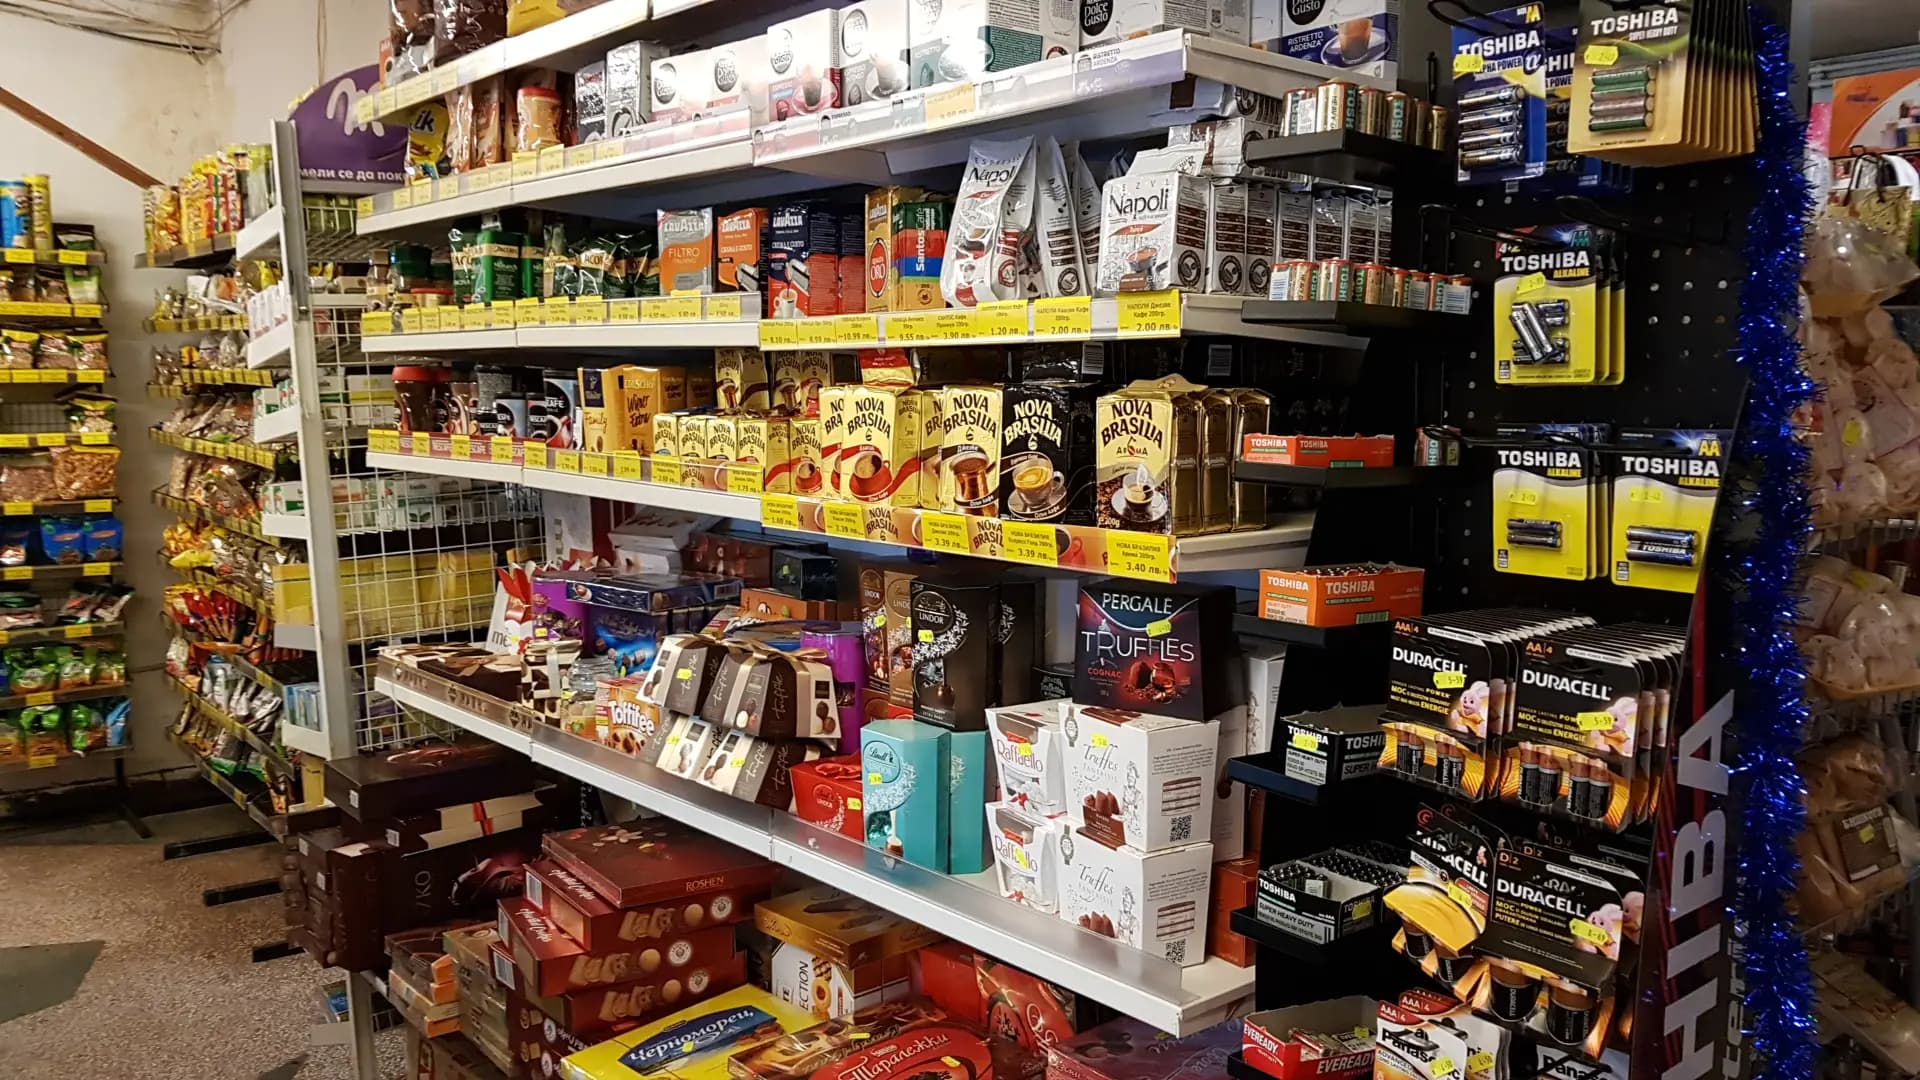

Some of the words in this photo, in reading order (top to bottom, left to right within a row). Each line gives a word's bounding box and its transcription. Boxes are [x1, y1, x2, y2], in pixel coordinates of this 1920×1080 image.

[1084, 1, 1109, 18] Dolce
[1292, 0, 1321, 16] Gusto
[1084, 10, 1109, 28] Gusto
[1591, 7, 1679, 36] TOSHIBA
[1287, 31, 1324, 46] RISTRETTO
[1289, 39, 1325, 53] ARDENZA
[1459, 30, 1541, 57] TOSHIBA
[1497, 57, 1523, 71] POWER
[337, 170, 354, 180] се
[356, 170, 376, 183] да
[1109, 188, 1170, 220] Napoli
[663, 219, 705, 233] LAVAZZA
[721, 219, 751, 233] LAVAZZA
[772, 214, 803, 228] LAVAZZA
[668, 247, 700, 258] FILTRO
[915, 229, 926, 272] Santos
[1501, 250, 1590, 272] TOSHIBA
[1553, 268, 1590, 278] ALKALINE
[991, 327, 1007, 336] 1.20
[1051, 326, 1069, 334] 2.00
[1136, 323, 1157, 332] 2.00
[855, 397, 885, 414] NOVA
[953, 393, 989, 412] NOVA
[1013, 399, 1054, 420] NOVA
[1111, 400, 1153, 420] NOVA
[713, 423, 731, 435] NOVA
[743, 424, 761, 435] NOVA
[796, 424, 816, 435] NOVA
[847, 413, 891, 439] BRASILIA
[943, 410, 997, 439] BRASILIA
[1003, 417, 1062, 448] BRASILIA
[1101, 418, 1163, 449] BRASILIA
[709, 436, 736, 453] BRASILIA
[739, 438, 765, 454] BRASILIA
[792, 437, 821, 455] BRASILIA
[1251, 438, 1287, 448] TOSHIBA
[1300, 440, 1329, 449] TOSHIBA
[1698, 439, 1721, 457] AA
[1498, 450, 1582, 468] TOSHIBA
[1621, 456, 1720, 477] TOSHIBA
[1547, 468, 1582, 478] ALKALINE
[1678, 476, 1720, 487] ALKALINE
[868, 506, 891, 519] NOVA
[866, 519, 899, 541] BRASILIA
[976, 519, 1003, 533] NOVA
[934, 537, 950, 547] 3.39
[973, 531, 1003, 551] BRASIL
[1018, 548, 1035, 558] 3.39
[1642, 545, 1686, 555] TOSHIBA
[1126, 562, 1146, 572] 3.40
[1267, 576, 1309, 591] TOSHIBA
[1325, 580, 1375, 594] TOSHIBA
[919, 613, 944, 625] LINDOR
[1395, 621, 1411, 632] AAA
[1080, 630, 1195, 663] TRUFFLES
[1526, 642, 1542, 653] AA
[1546, 646, 1553, 655] 4
[1392, 646, 1467, 678] DURACELL
[1087, 667, 1122, 679] COGNAC
[1391, 685, 1406, 696] MOC
[1522, 669, 1611, 701] DURACELL
[1425, 688, 1450, 698] POWER
[1420, 701, 1449, 715] ENERGIE
[608, 701, 656, 736] Toffifee
[1518, 712, 1537, 723] MOC
[1559, 713, 1576, 722] POW
[1345, 734, 1386, 750] TOSHI
[1082, 737, 1120, 773] Truffes
[994, 834, 1039, 873] Raffllo
[1499, 852, 1509, 863] D
[1512, 857, 1519, 865] 2
[685, 876, 725, 891] ROSHEN
[1078, 862, 1115, 896] Truffes
[1259, 877, 1297, 903] TOSHIBA
[1496, 878, 1586, 918] DURACELL
[1496, 900, 1514, 912] MOC
[1520, 902, 1543, 913] POWER
[1259, 902, 1277, 915] SUPER
[1277, 908, 1297, 924] HEAVY
[1298, 918, 1315, 930] DUTY
[1495, 912, 1520, 926] PUTERE
[1402, 996, 1420, 1009] AAA
[1424, 1003, 1430, 1011] 4
[1380, 1003, 1397, 1018] AAA
[1400, 1014, 1406, 1022] 4
[1243, 1023, 1279, 1054] EVEREADY
